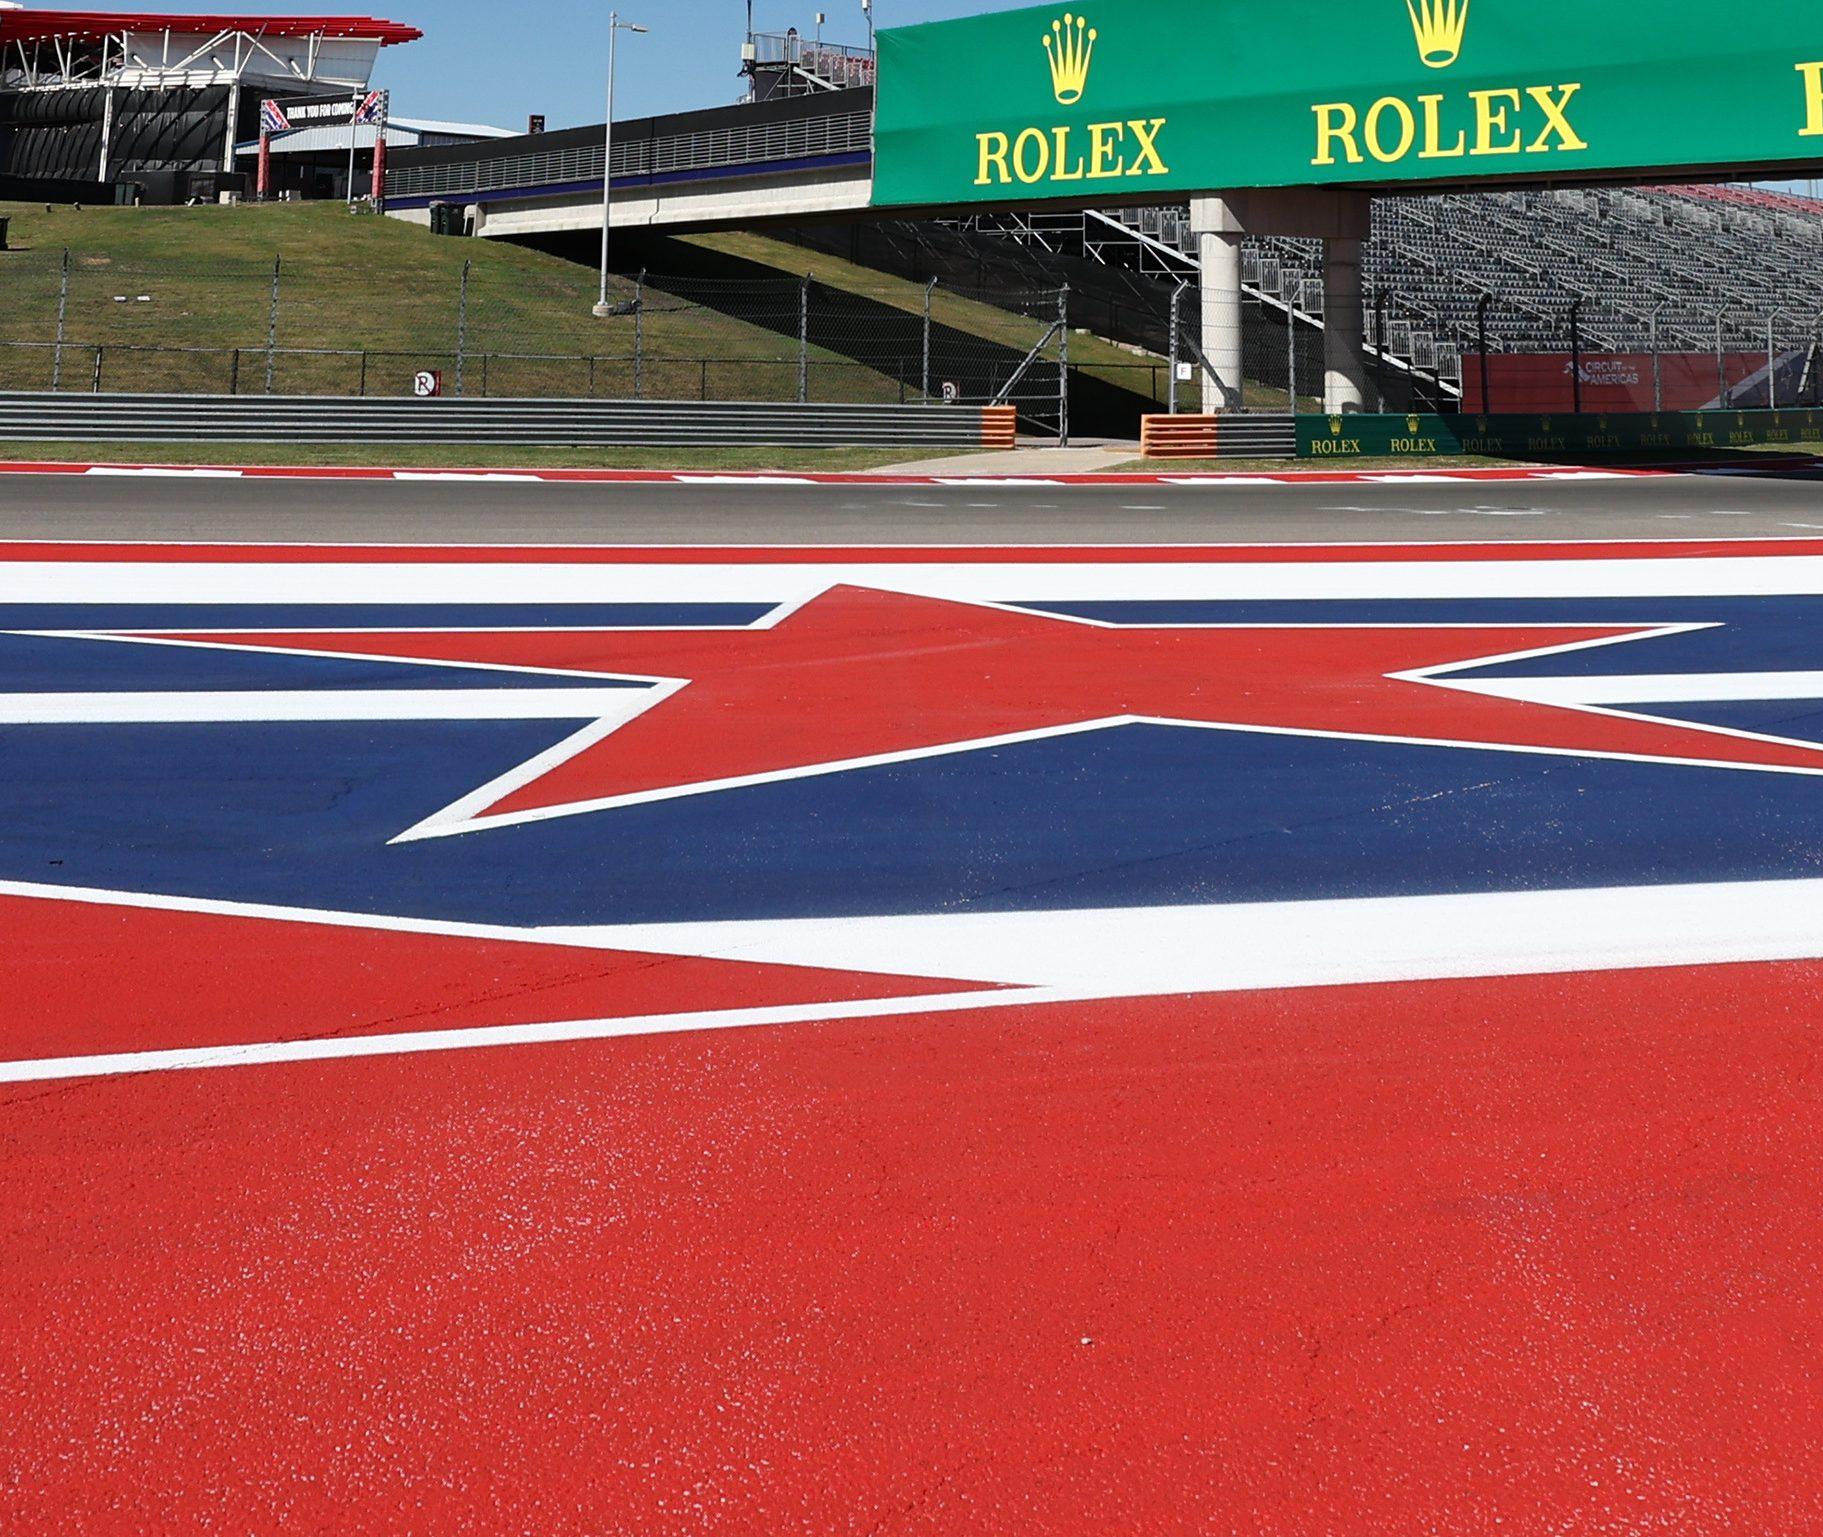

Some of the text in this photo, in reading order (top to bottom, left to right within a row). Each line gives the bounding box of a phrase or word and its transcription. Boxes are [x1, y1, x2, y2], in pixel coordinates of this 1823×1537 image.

[287, 107, 306, 119] THANK
[307, 105, 319, 118] YOU
[320, 104, 331, 117] FOR
[1312, 82, 1587, 166] ROLEX
[975, 118, 1169, 185] ROLEX
[1585, 361, 1622, 373] CIRCUIT
[1590, 373, 1640, 384] AMERICAS
[1311, 439, 1361, 454] ROLEX
[1390, 438, 1436, 452] ROLEX
[1462, 438, 1504, 452] ROLEX
[1528, 437, 1567, 450] ROLEX
